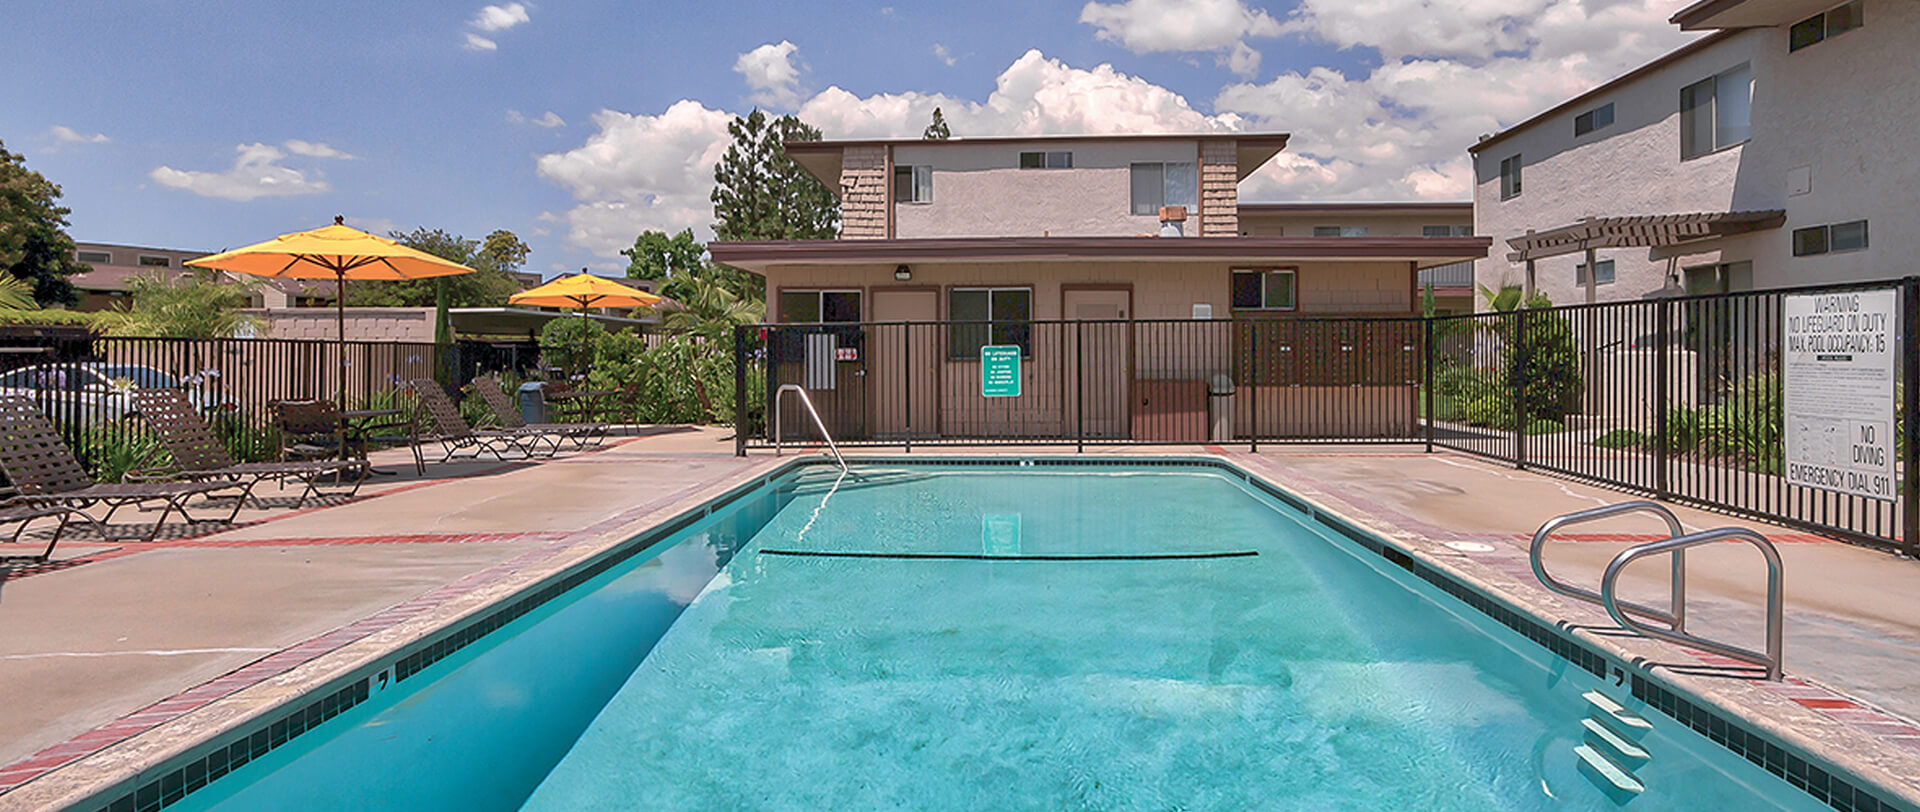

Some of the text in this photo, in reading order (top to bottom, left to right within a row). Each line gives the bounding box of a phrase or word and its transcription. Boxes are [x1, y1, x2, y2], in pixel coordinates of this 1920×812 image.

[1814, 294, 1860, 313] WARNING
[1789, 312, 1887, 333] NO LIFEGUARD ON DUTY
[1808, 334, 1825, 353] POOL
[1828, 334, 1873, 353] OCCUPANCY:
[1875, 333, 1886, 353] 15
[1861, 425, 1875, 444] NO
[1853, 444, 1884, 467] DIVING
[1790, 463, 1890, 495] EMERGENCY DIAL 911
